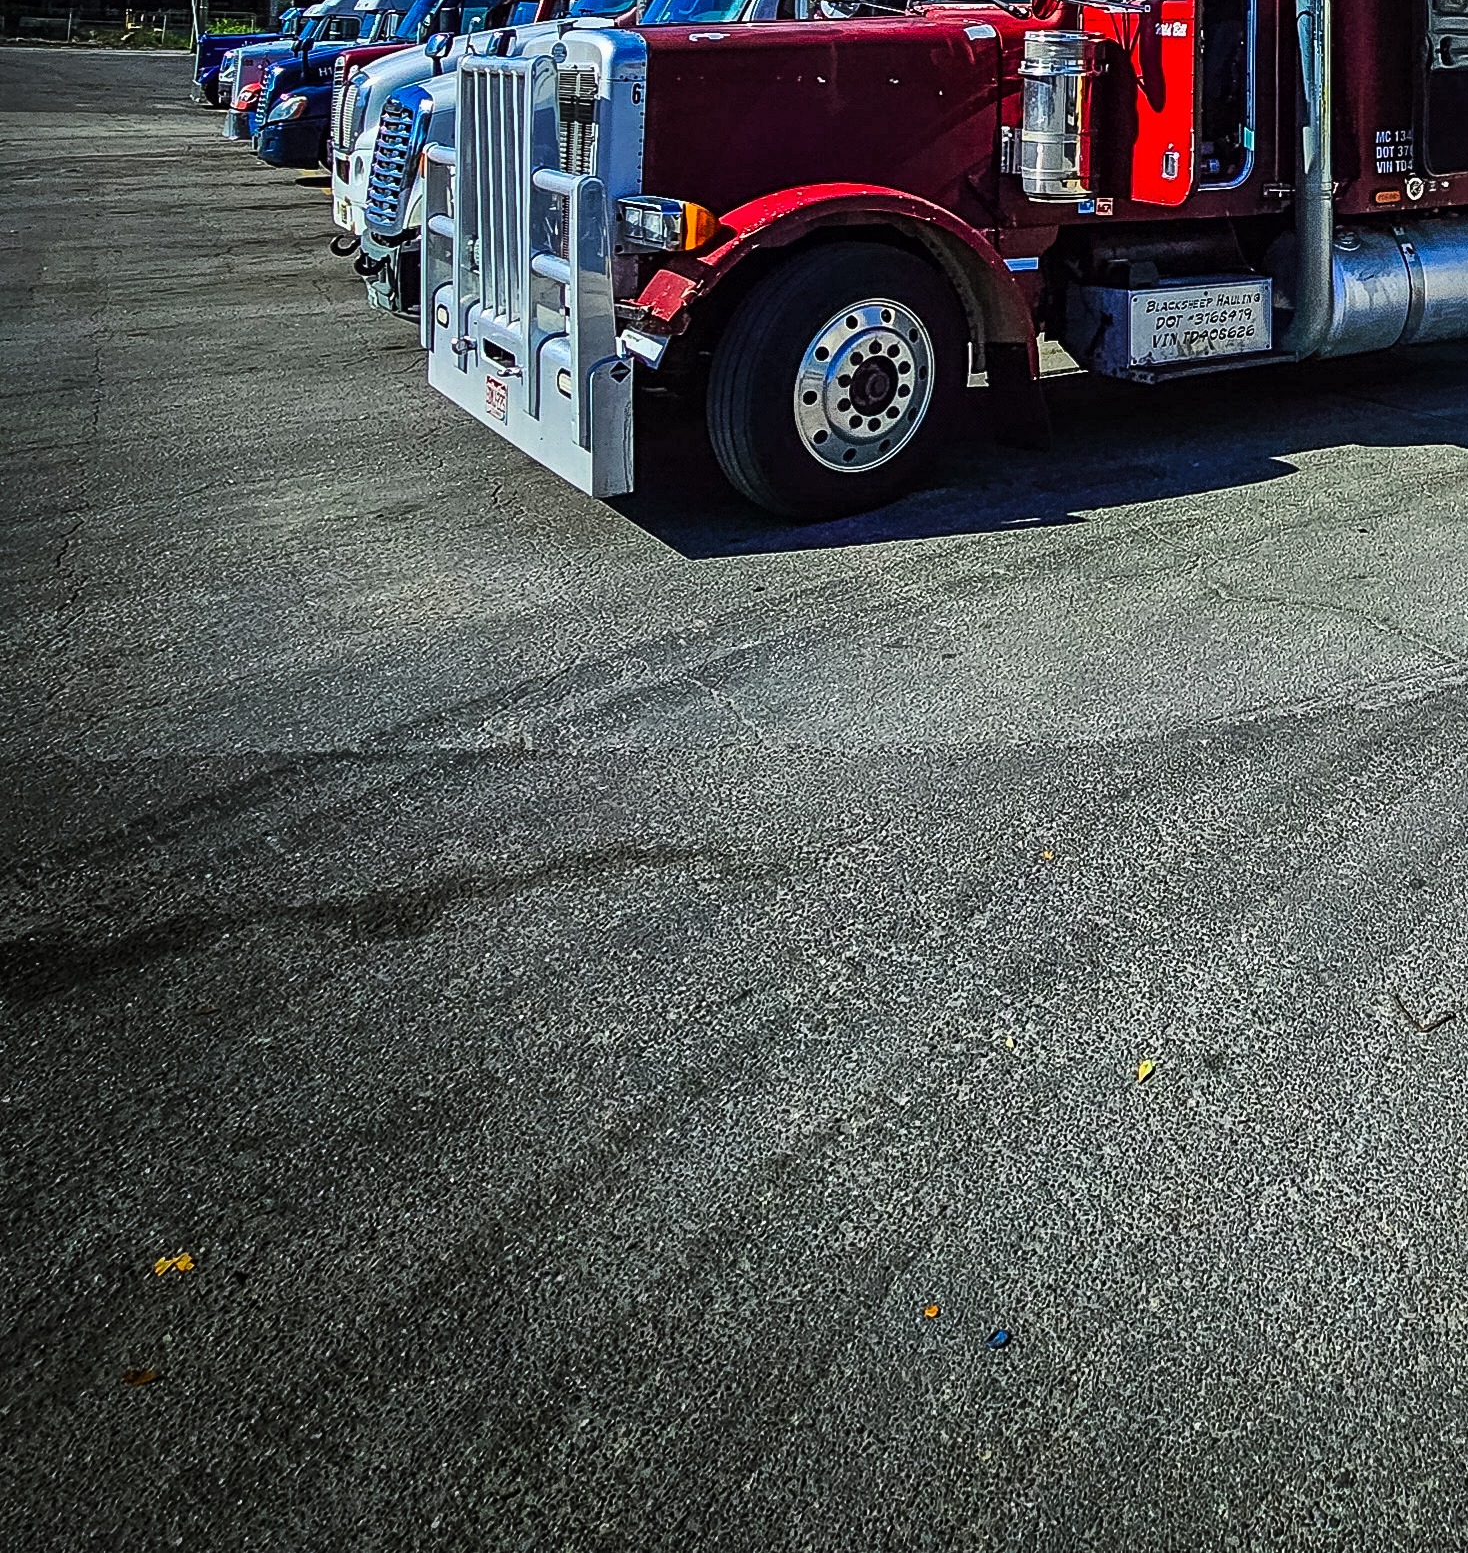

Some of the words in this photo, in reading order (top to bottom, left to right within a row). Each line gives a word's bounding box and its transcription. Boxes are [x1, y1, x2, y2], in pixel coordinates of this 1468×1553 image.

[632, 81, 642, 105] 6
[1375, 130, 1392, 144] MC
[1376, 145, 1395, 159] DOT
[1376, 160, 1393, 174] VIN
[1156, 315, 1183, 330] DOT
[1152, 332, 1178, 349] VIN
